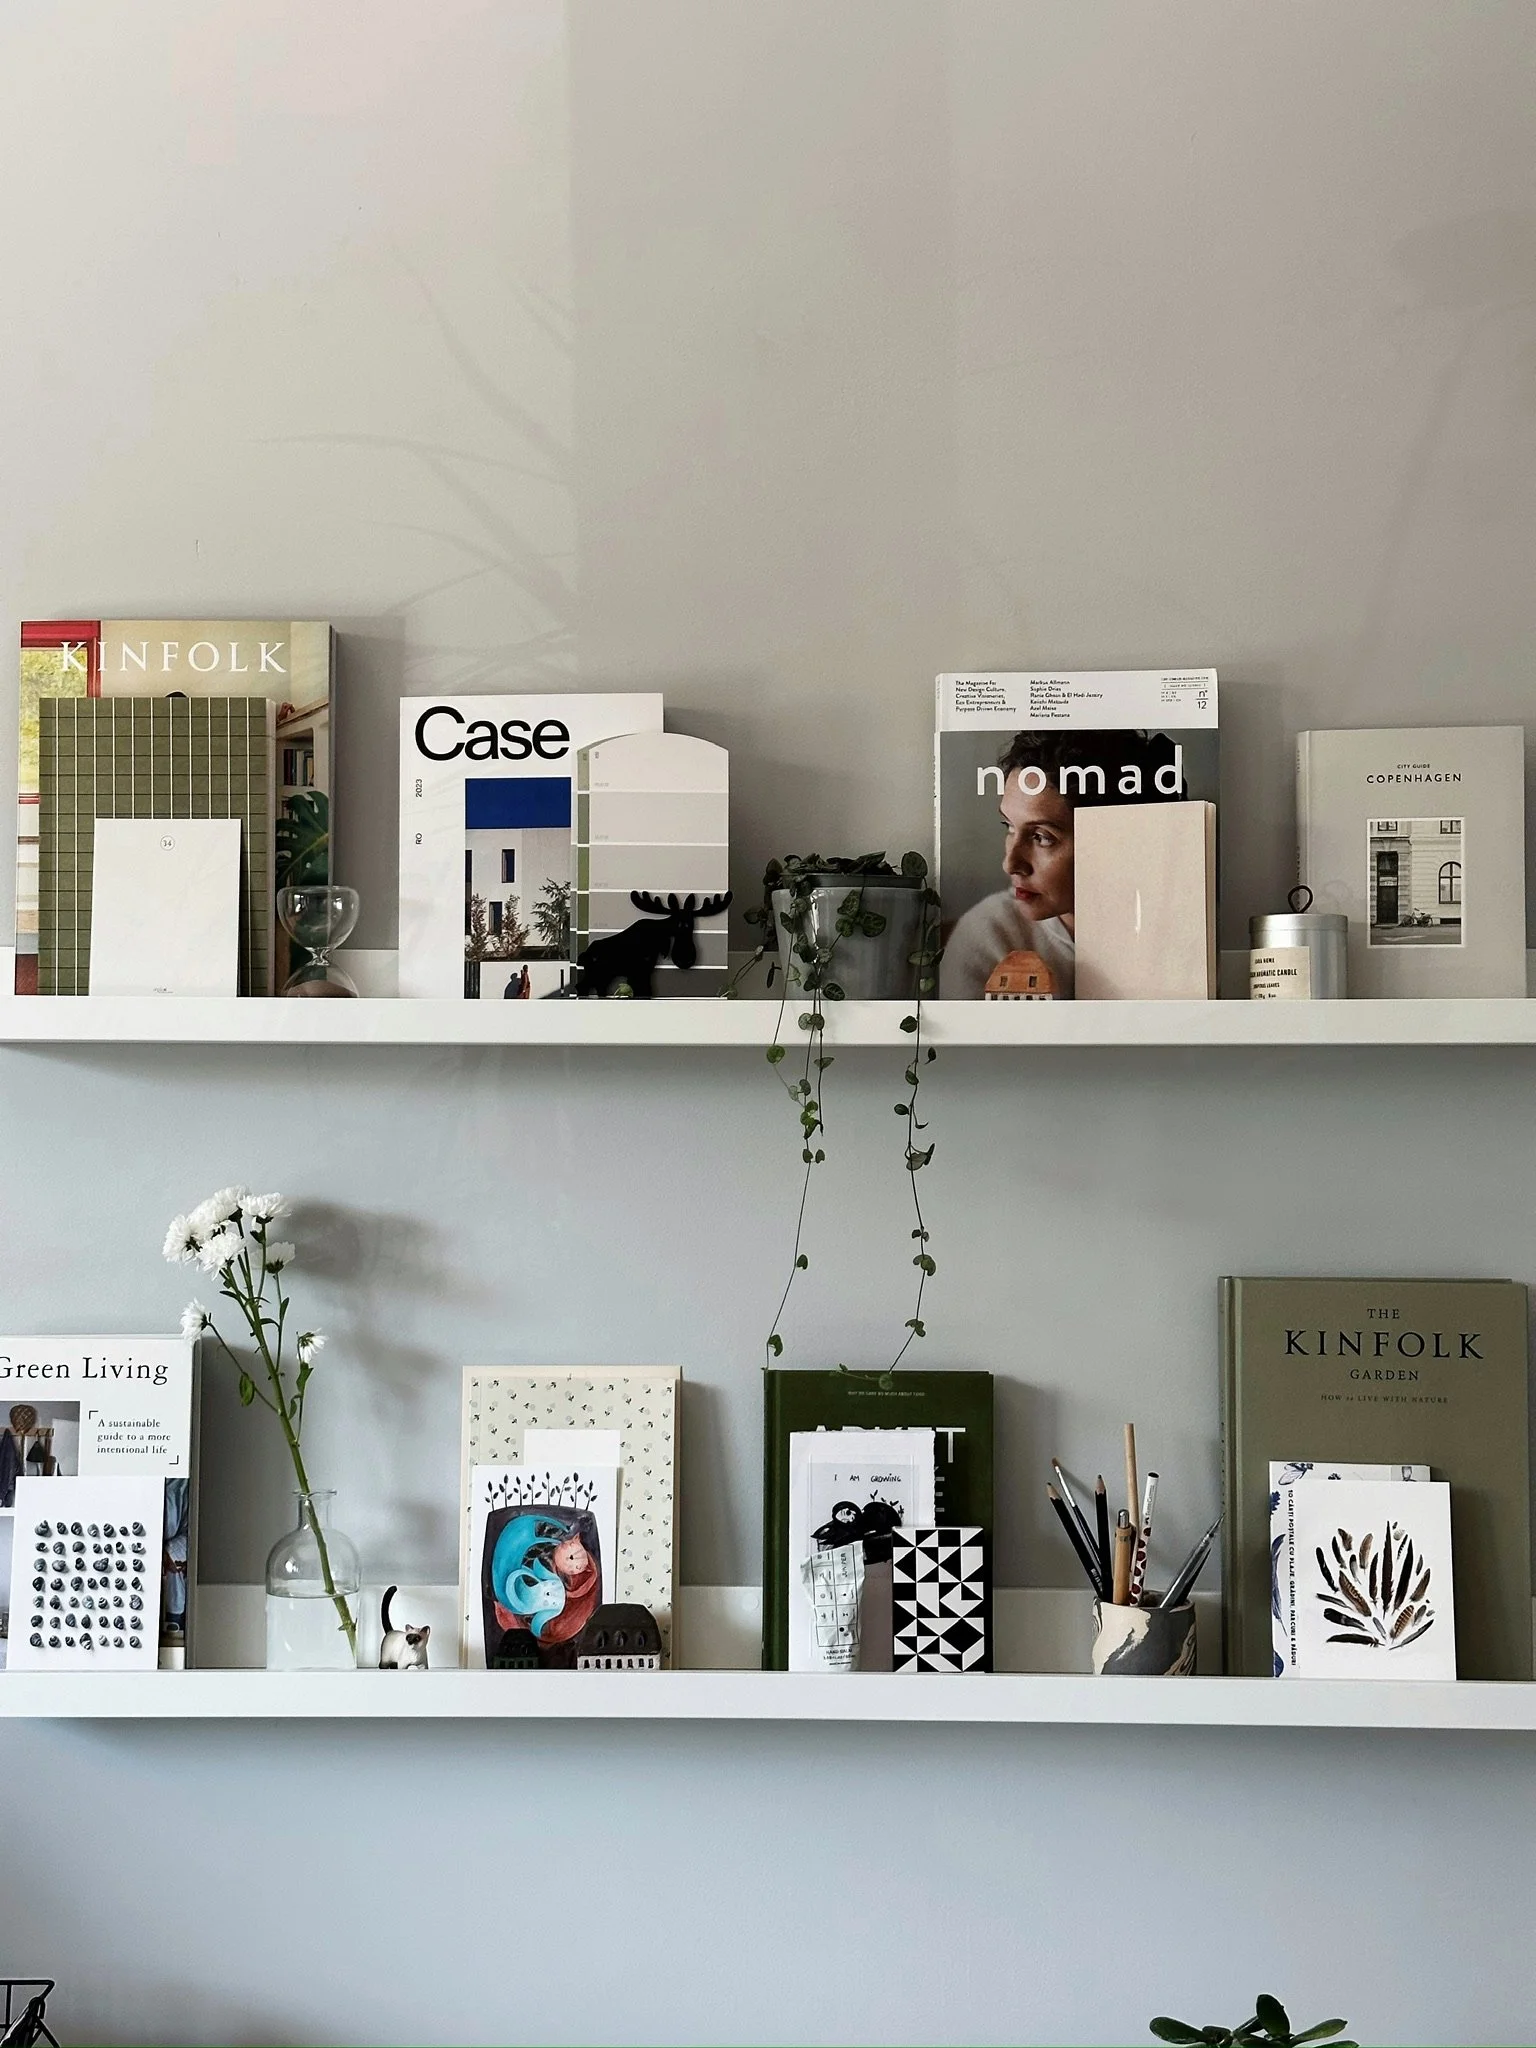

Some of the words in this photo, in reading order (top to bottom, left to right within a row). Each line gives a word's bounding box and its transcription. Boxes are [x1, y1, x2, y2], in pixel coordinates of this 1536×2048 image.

[60, 640, 287, 673] KINFOLK
[1198, 700, 1207, 710] 12
[415, 705, 570, 761] Case
[977, 744, 1184, 796] nomad
[1366, 773, 1462, 784] COPENHAGEN
[415, 833, 422, 845] RO
[1366, 1308, 1400, 1320] THE
[1283, 1329, 1485, 1360] KINFOLK
[0, 1356, 71, 1379] Green
[82, 1356, 169, 1386] Living
[1350, 1368, 1420, 1382] GARDEN
[98, 1419, 105, 1427] A
[109, 1418, 161, 1427] sustainable
[97, 1432, 123, 1442] guide
[97, 1445, 149, 1454] intentional
[152, 1445, 167, 1454] life
[1288, 1490, 1293, 1498] 10
[1289, 1546, 1295, 1555] CU
